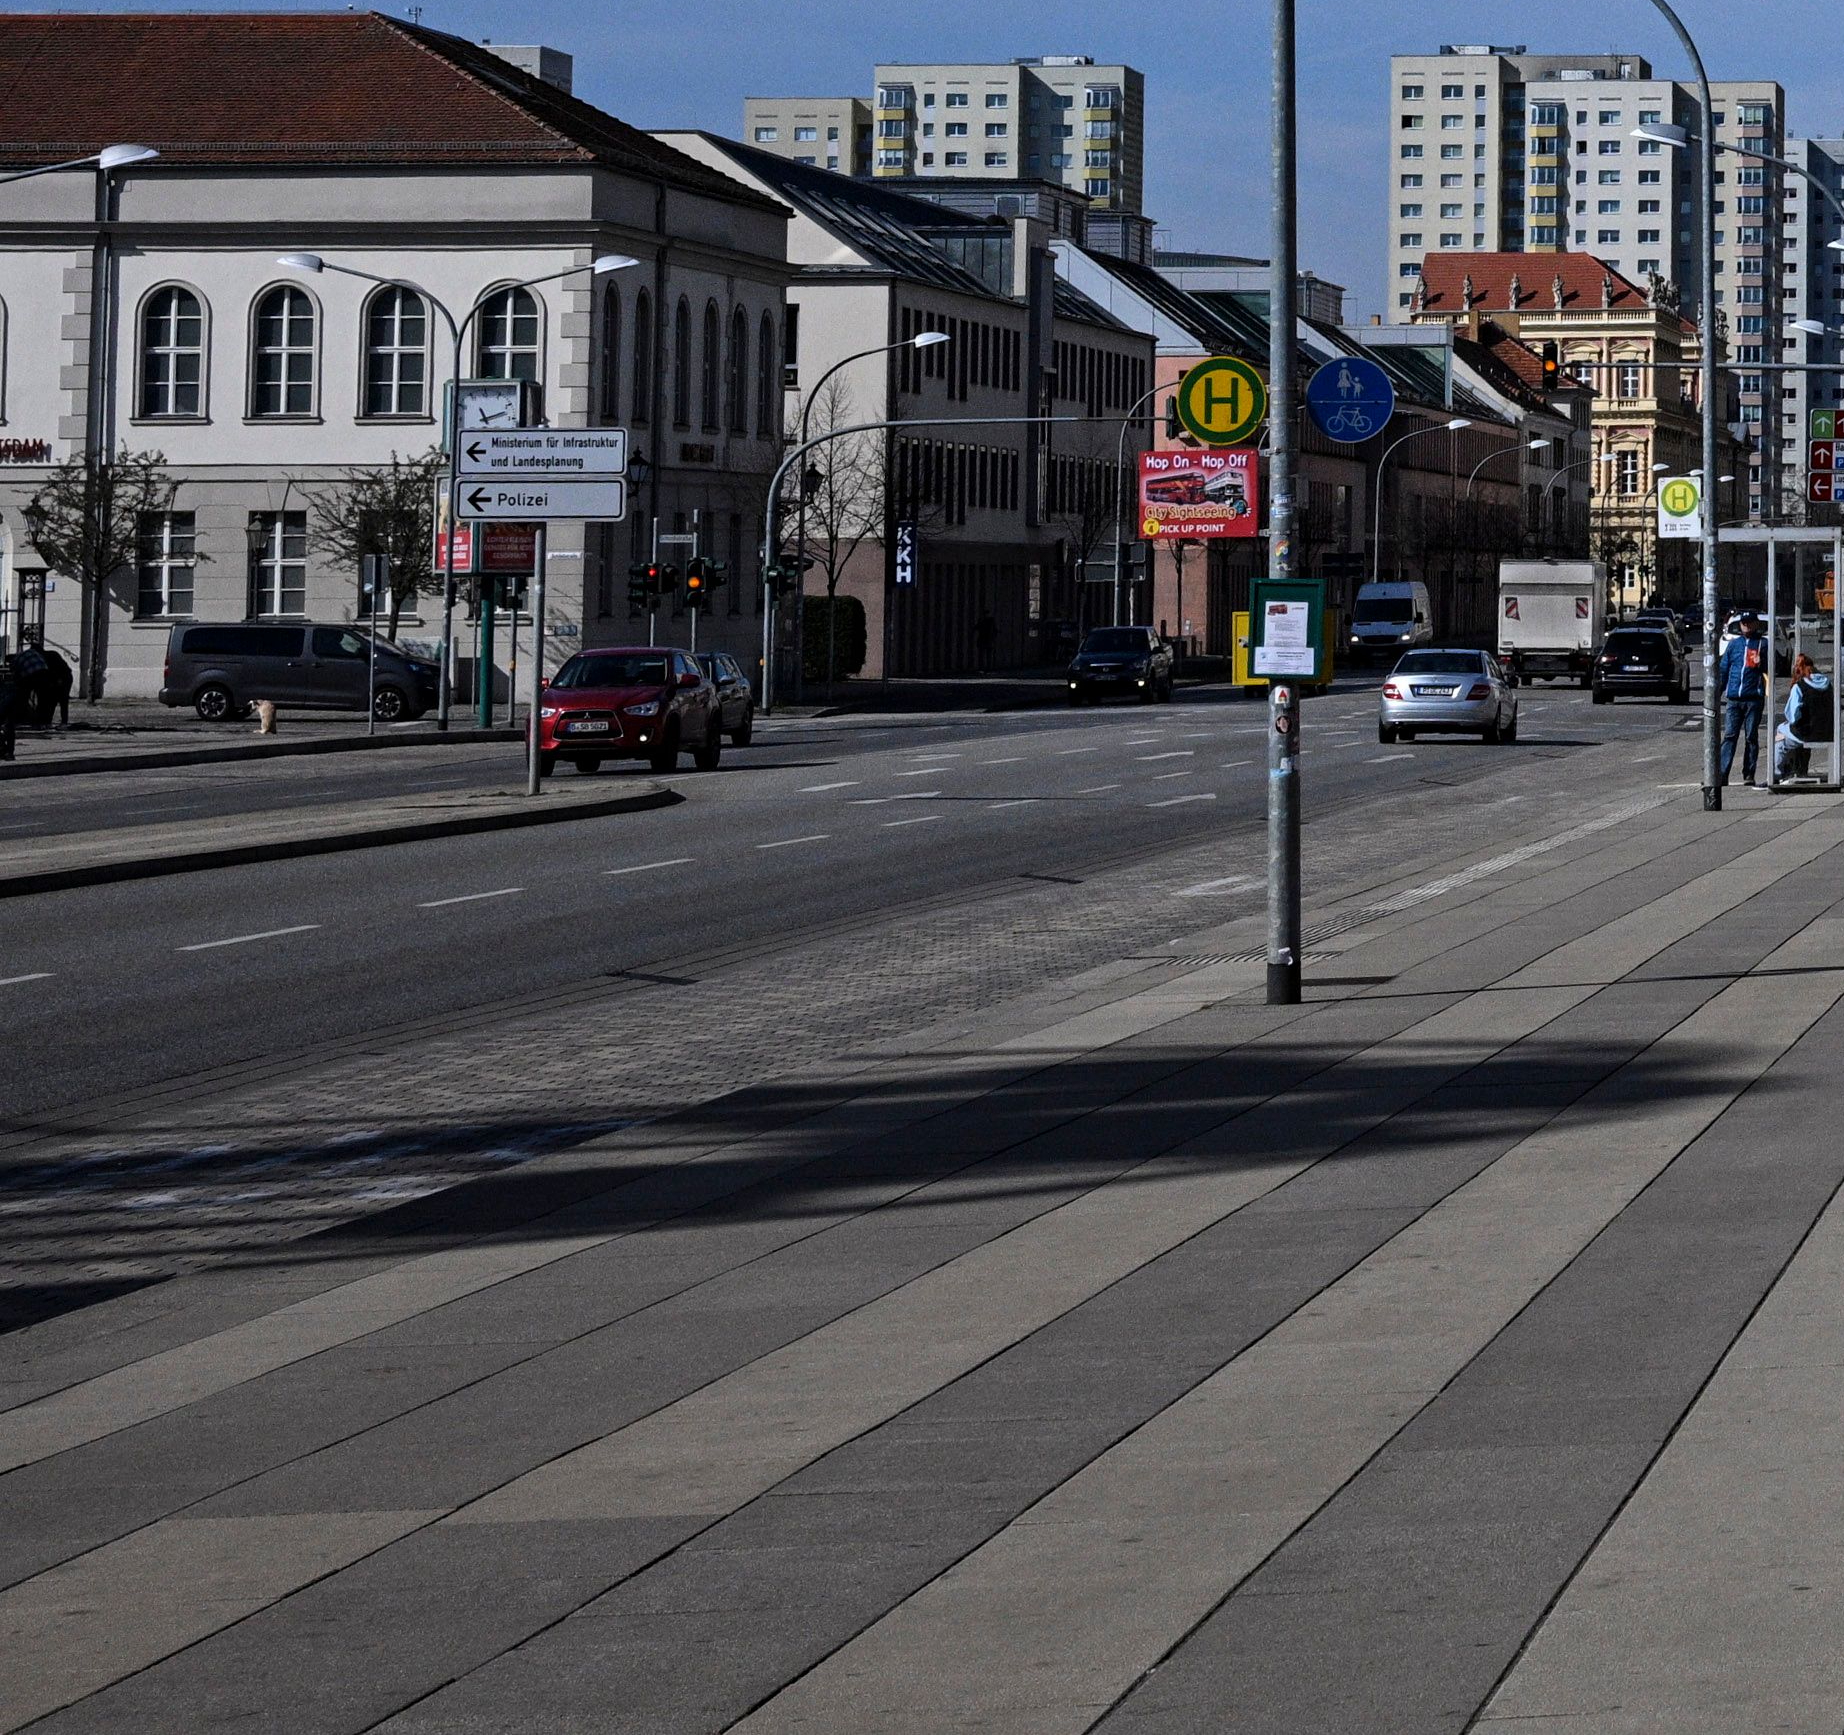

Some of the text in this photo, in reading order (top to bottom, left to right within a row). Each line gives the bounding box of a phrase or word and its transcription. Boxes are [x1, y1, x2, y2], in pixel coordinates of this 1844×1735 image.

[1204, 377, 1239, 424] H
[491, 437, 619, 448] Ministerium für Infrastruktur
[491, 456, 584, 469] und Landesplanung
[1145, 455, 1169, 469] Hop
[1173, 455, 1190, 467] On
[1201, 455, 1225, 470] Hop
[1228, 454, 1248, 467] Off
[497, 493, 549, 507] Polizei
[1672, 487, 1688, 509] H
[1145, 505, 1237, 522] City Sightseeing
[1159, 525, 1179, 533] PICK
[1181, 524, 1195, 533] UP
[1196, 524, 1225, 532] POINT
[896, 527, 912, 583] KKH
